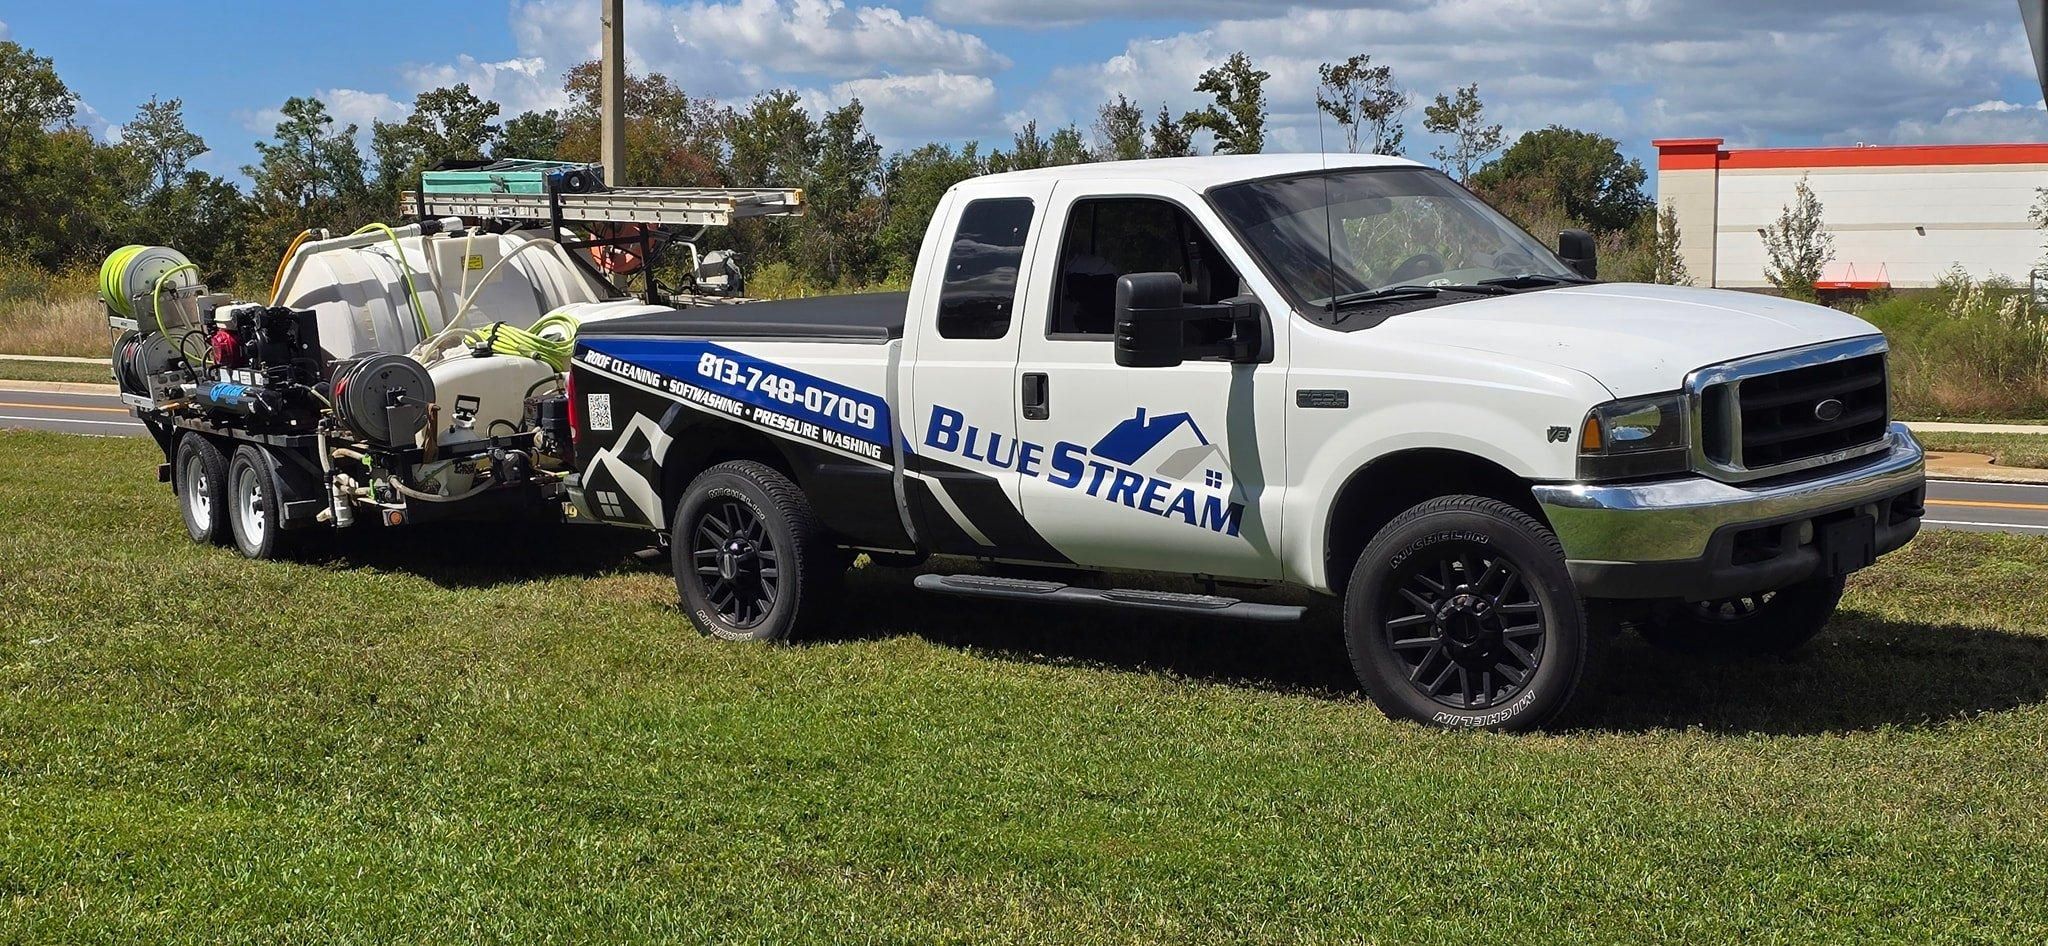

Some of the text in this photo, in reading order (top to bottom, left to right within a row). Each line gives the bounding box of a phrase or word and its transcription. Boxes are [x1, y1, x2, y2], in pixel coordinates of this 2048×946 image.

[584, 349, 882, 460] ROOF CLEANING SOFTWASHING PRESSURE WASHING
[697, 352, 876, 430] 813-748-0709
[708, 487, 766, 520] MICHELIN
[1047, 440, 1245, 538] STREAM
[1390, 530, 1489, 569] MICHELIN
[1433, 690, 1536, 727] MICHELIN
